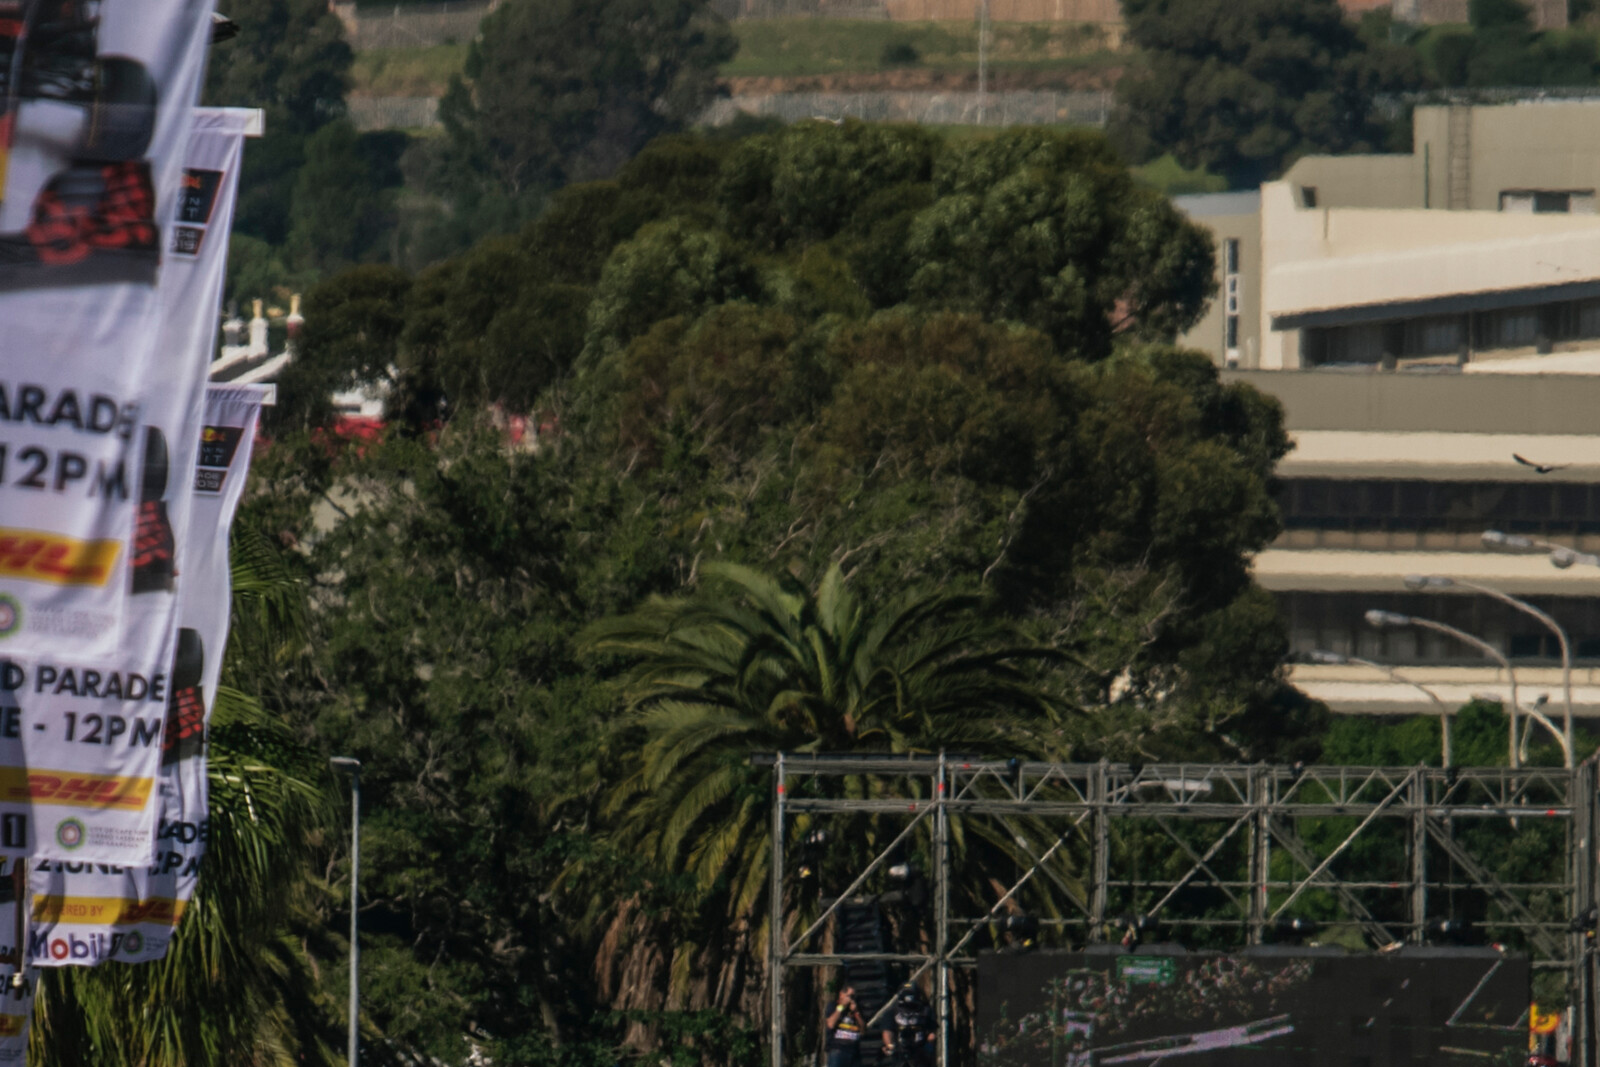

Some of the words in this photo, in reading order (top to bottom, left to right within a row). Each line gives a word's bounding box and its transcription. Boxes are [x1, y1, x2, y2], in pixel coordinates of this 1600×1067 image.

[36, 665, 165, 703] PARADE
[64, 712, 162, 748] 12PM
[18, 775, 142, 805] DHL
